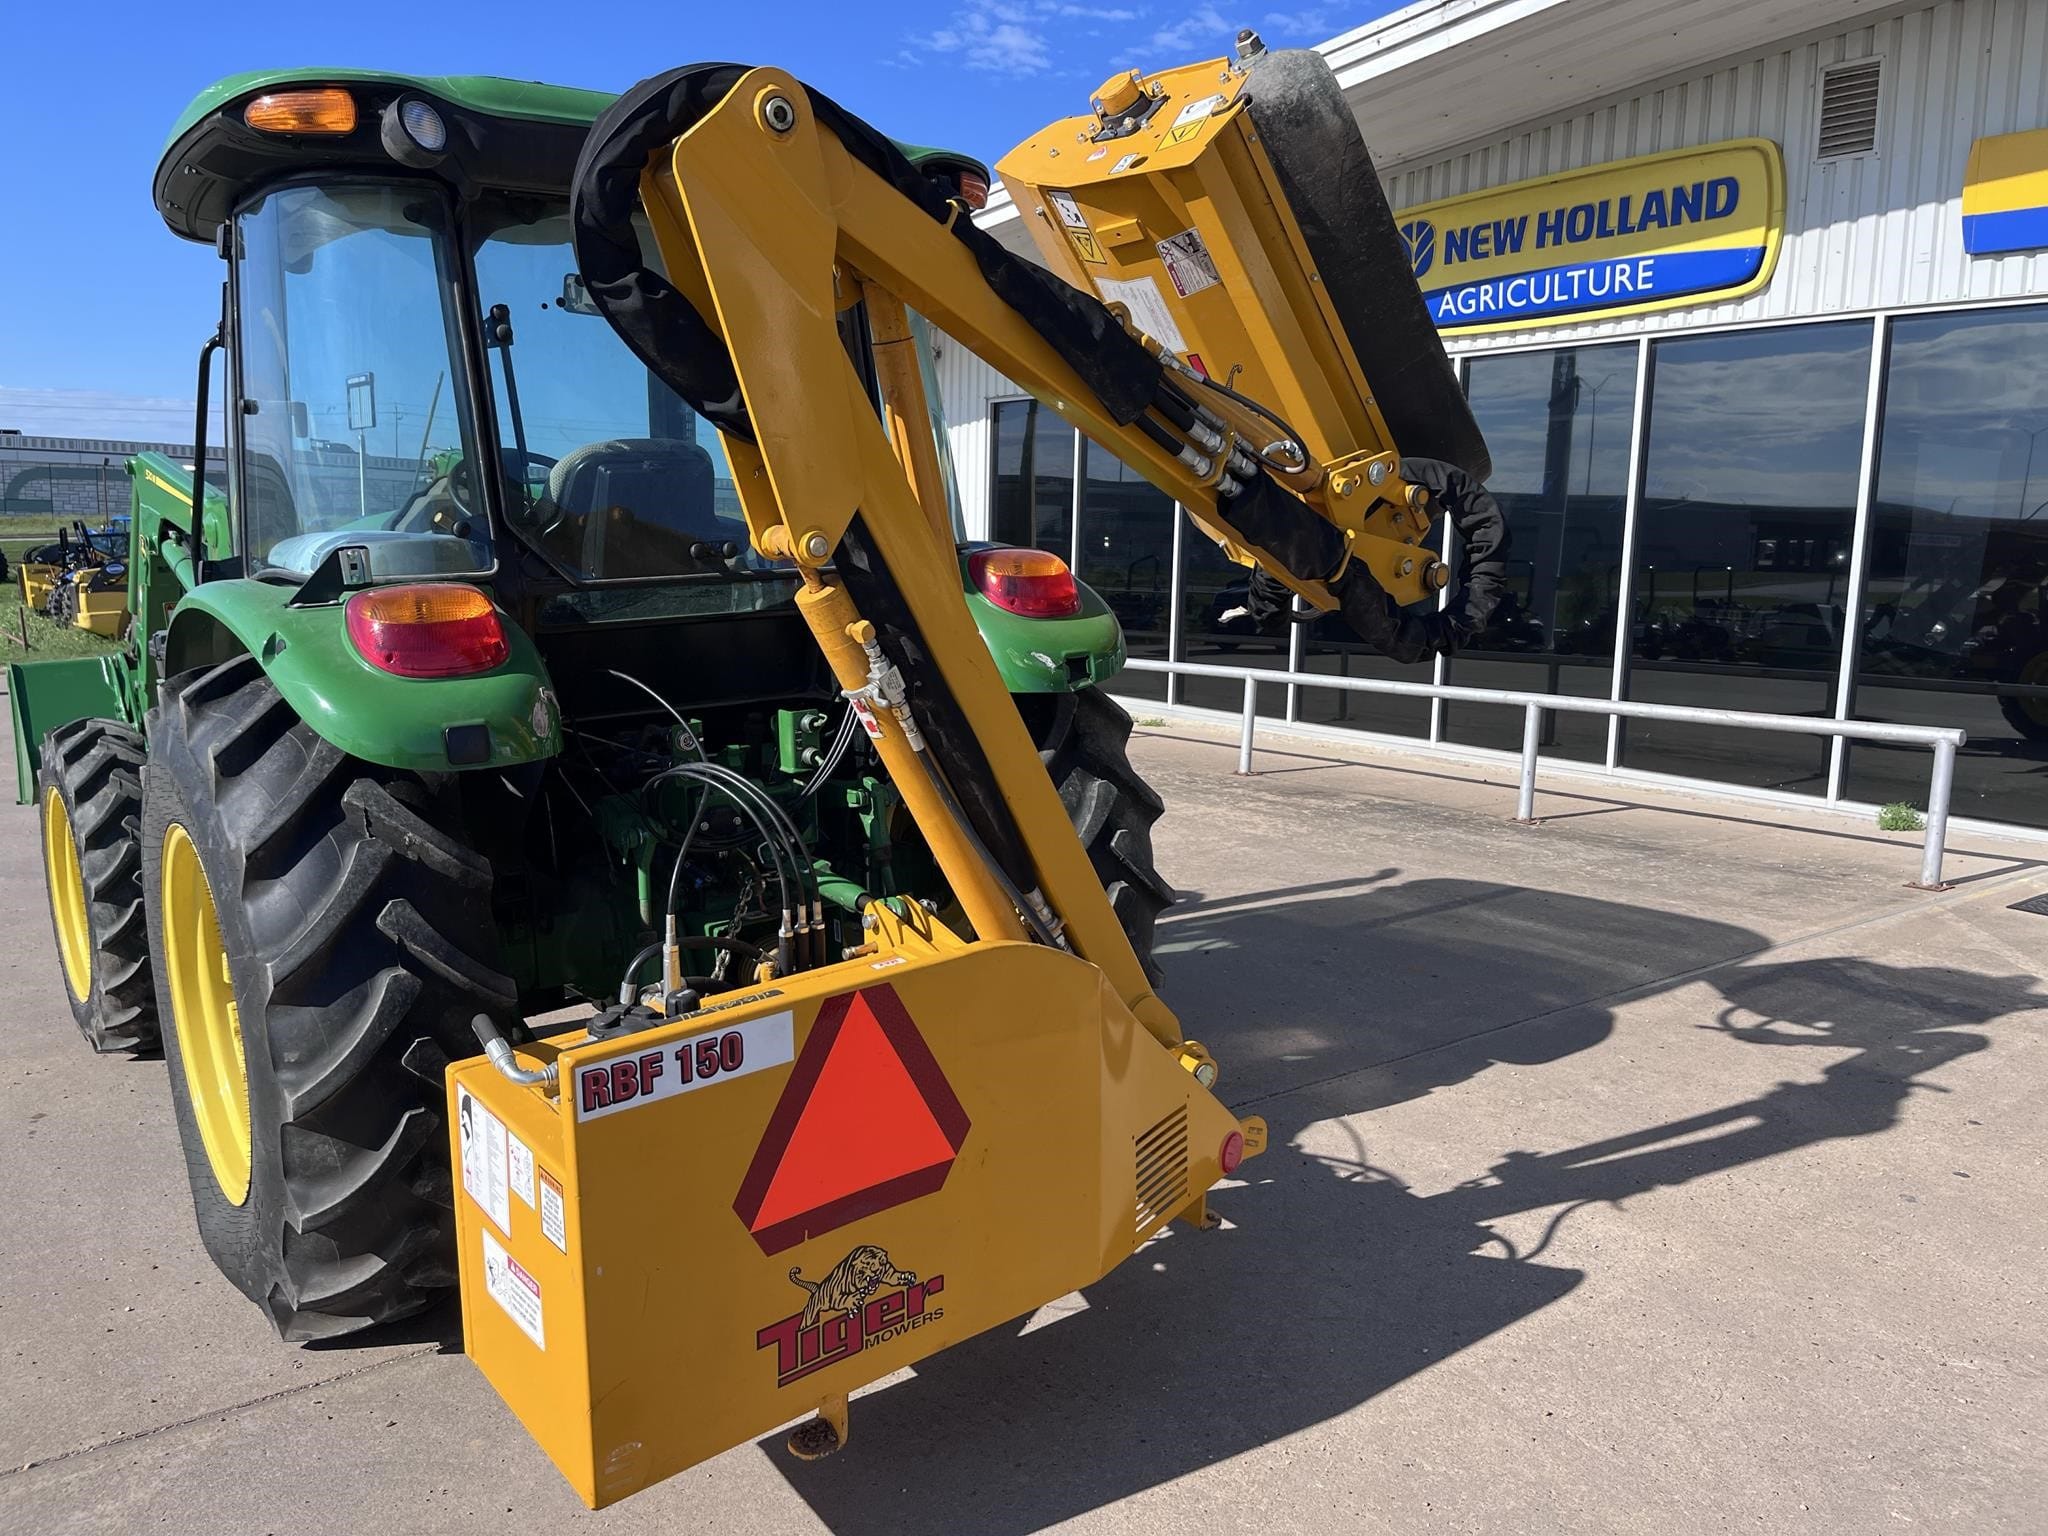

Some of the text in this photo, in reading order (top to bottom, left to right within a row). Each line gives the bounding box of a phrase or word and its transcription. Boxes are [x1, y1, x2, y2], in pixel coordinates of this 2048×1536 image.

[1443, 176, 1740, 265] NEW HOLLAND
[1437, 259, 1655, 318] AGRICULTURE
[581, 1031, 744, 1113] RBF 150
[757, 1275, 944, 1388] Tiger
[865, 1307, 944, 1350] MOWERS
